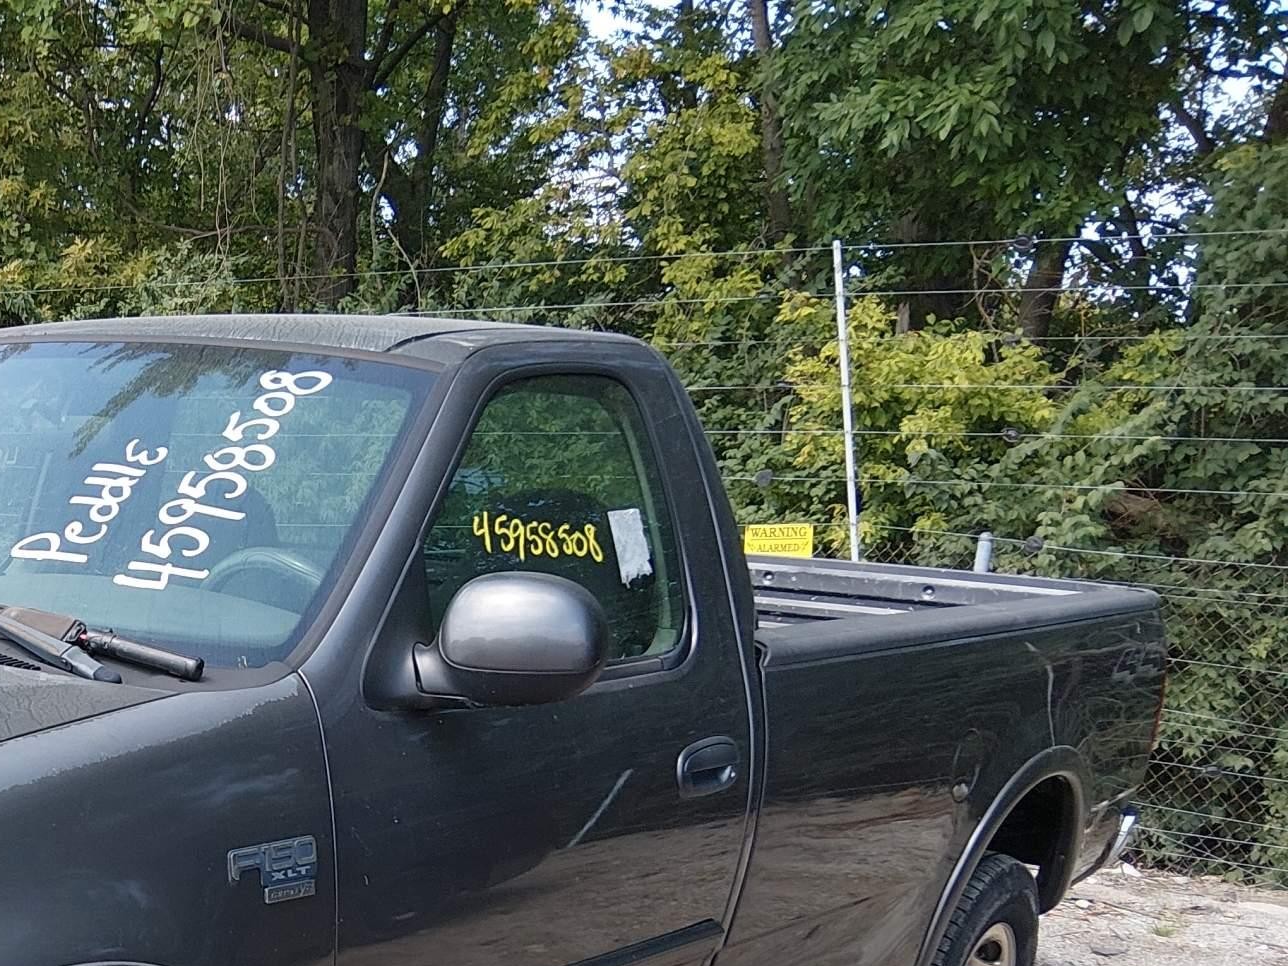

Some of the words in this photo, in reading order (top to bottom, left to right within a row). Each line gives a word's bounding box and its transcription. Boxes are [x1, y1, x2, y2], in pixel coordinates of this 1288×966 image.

[112, 369, 334, 591] 45958508
[472, 511, 604, 563] 45958508
[751, 526, 807, 538] WARNING
[756, 543, 800, 553] ALARMED
[271, 865, 311, 881] XLT
